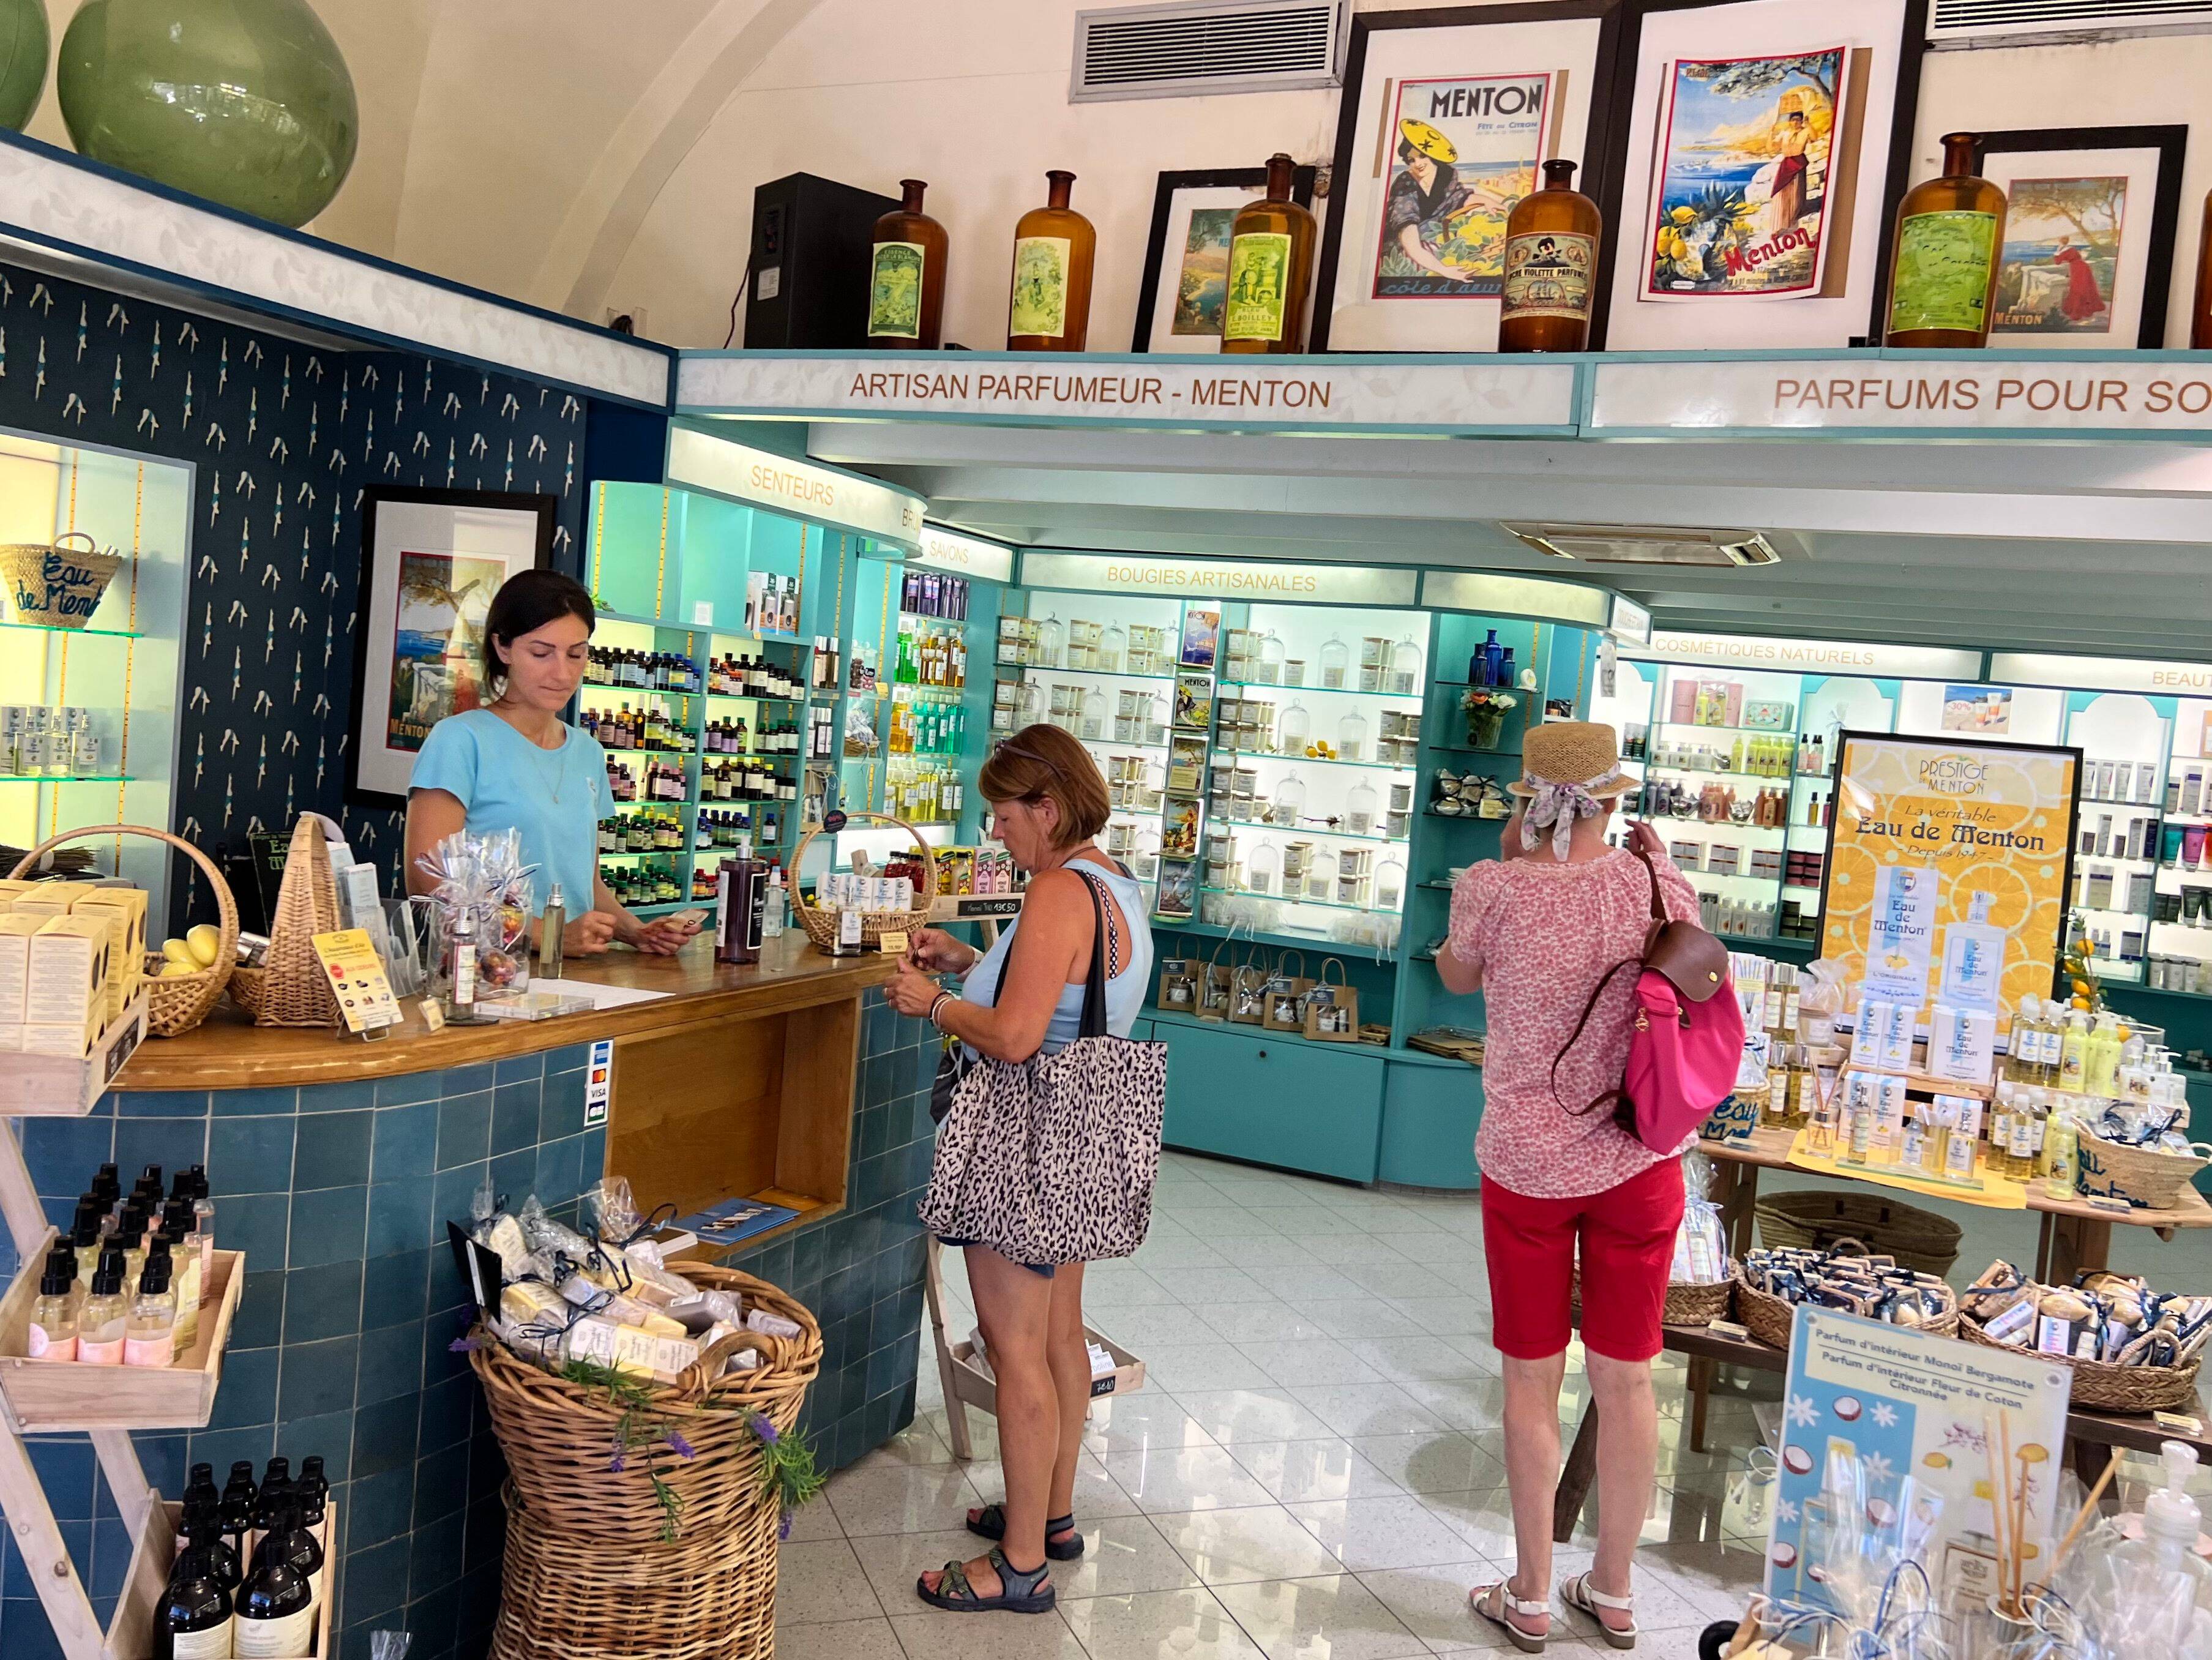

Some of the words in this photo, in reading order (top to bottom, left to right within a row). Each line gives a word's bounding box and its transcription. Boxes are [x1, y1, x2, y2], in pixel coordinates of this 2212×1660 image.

[1430, 84, 1543, 118] MENTON
[1724, 228, 1815, 276] Menton
[1994, 312, 2042, 325] MENTON
[850, 373, 969, 400] ARTISAN
[978, 375, 1162, 405] PARFUMEUR
[1192, 378, 1331, 408] MENTON
[1774, 379, 1979, 410] PARFUMS
[1995, 379, 2128, 412] POUR
[751, 465, 834, 506] SENTEURS
[930, 540, 968, 563] SAVONS
[1107, 566, 1186, 585] BOUGIES
[1190, 570, 1317, 592] ARTISANALES
[1655, 638, 1775, 659] COSMÉTIQUES
[1780, 646, 1874, 665] NATURELS
[1919, 760, 1989, 780] PRESTIGE
[1928, 779, 1984, 795] MENTON
[1905, 805, 1924, 816] La
[1929, 807, 1997, 823] véritable
[1855, 816, 1902, 837] Eau
[1911, 821, 1940, 840] de
[1952, 824, 2044, 851] Menton
[1907, 845, 1953, 860] Depuis
[1892, 899, 1916, 913] Eau
[1895, 912, 1910, 923] de
[1874, 920, 1924, 936] Menton
[591, 1088, 606, 1098] VISA
[1815, 1328, 1856, 1346] Parfum
[1924, 1355, 1963, 1372] Monoï
[1966, 1366, 2035, 1391] Bergamote
[1822, 1352, 1863, 1369] Parfum
[1931, 1378, 1962, 1394] Fleur
[1965, 1388, 1980, 1399] de
[1984, 1392, 2023, 1409] Coton
[1889, 1379, 1948, 1401] Citronnée
